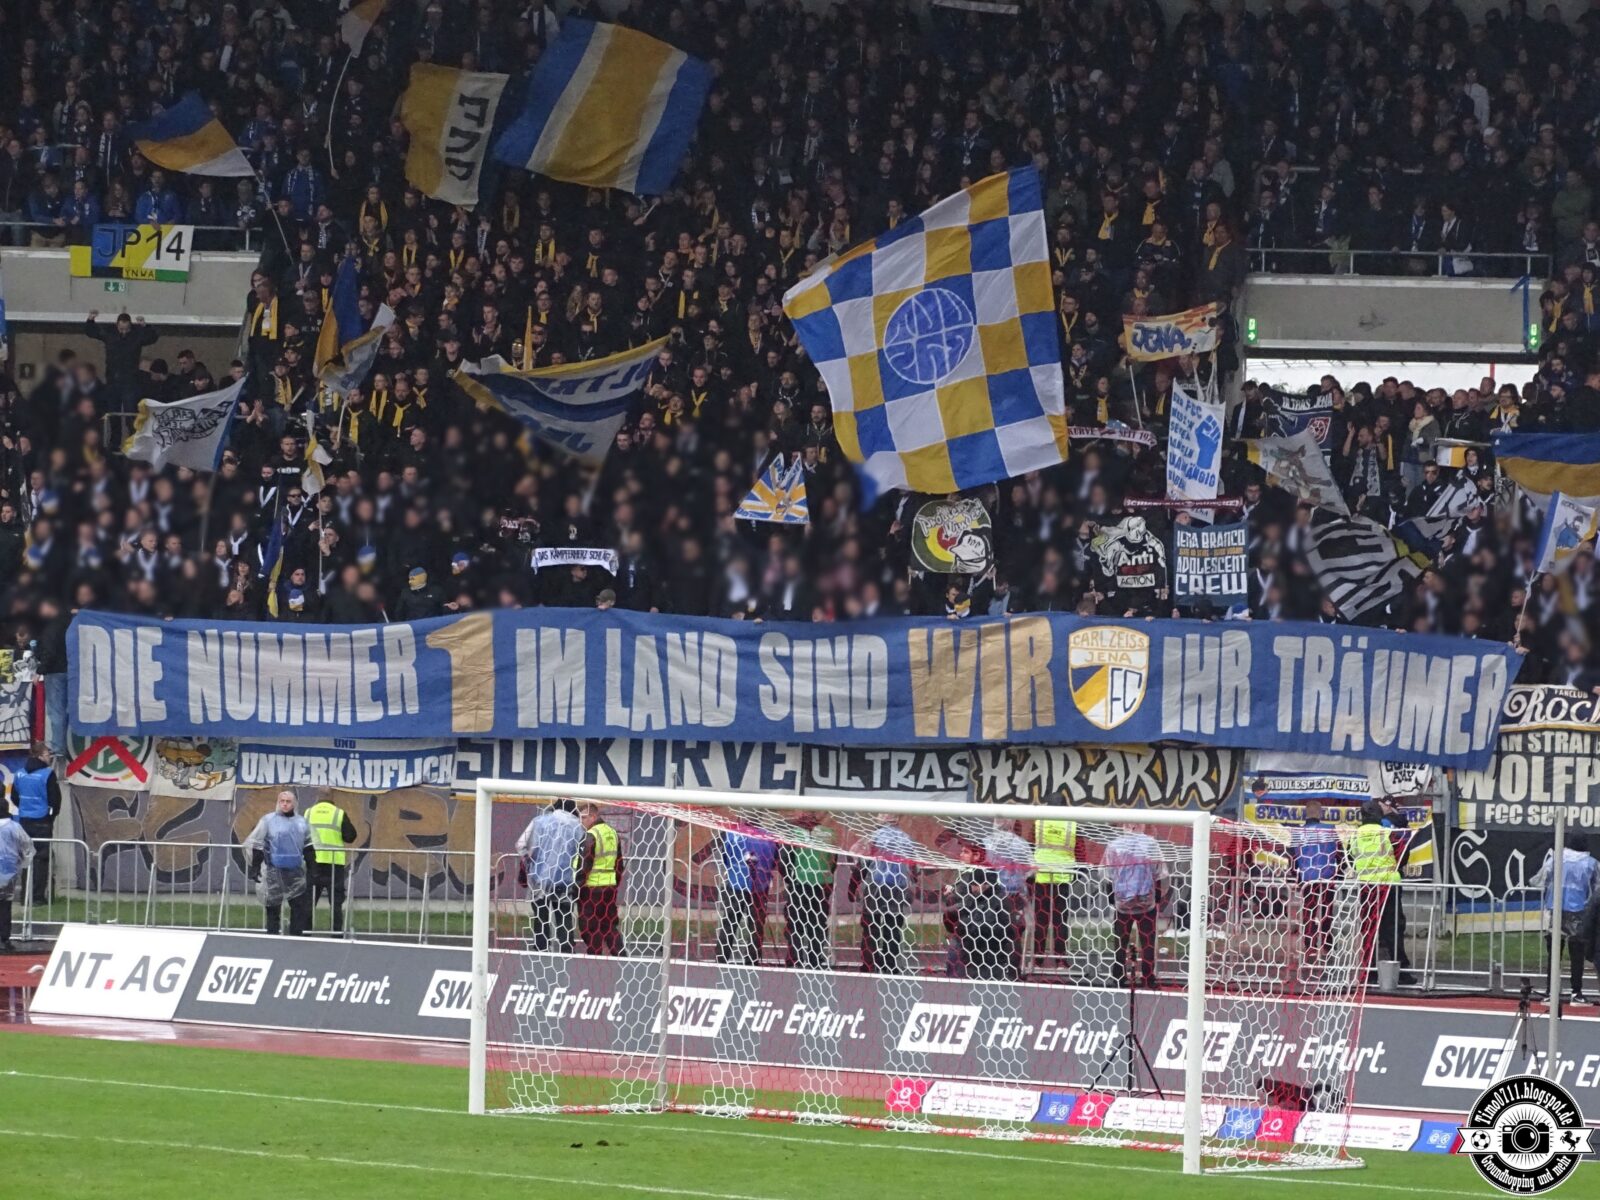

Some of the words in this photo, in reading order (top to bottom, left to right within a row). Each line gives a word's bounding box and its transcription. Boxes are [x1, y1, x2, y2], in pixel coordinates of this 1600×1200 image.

[124, 269, 155, 278] YNWA
[1201, 529, 1246, 549] BRANCO
[1118, 548, 1153, 567] Anti
[1176, 555, 1247, 575] ADOLESCENT
[1121, 575, 1154, 586] ACTION
[1175, 573, 1248, 596] CREW
[1084, 652, 1132, 664] JENA
[78, 624, 167, 727] DIE
[187, 623, 419, 726] NUMMER
[425, 611, 495, 733] 1
[515, 627, 586, 728] IM
[605, 627, 738, 732] LAND
[759, 631, 888, 733] SIND
[908, 616, 1056, 740] WIR
[1162, 630, 1251, 735] IHR
[1273, 635, 1508, 755] TRÄUMER
[1110, 667, 1142, 724] FC
[334, 739, 356, 749] UND
[241, 753, 454, 788] UNVERKÄUFLICH
[811, 750, 969, 790] ULTRAS
[975, 749, 1233, 801] HARAKIRI
[1267, 780, 1335, 791] ADOLESCENT
[1337, 781, 1370, 793] CREW
[1256, 805, 1341, 822] SAALLD
[1485, 803, 1523, 825] FCC
[208, 964, 262, 996] SWE
[273, 969, 319, 999] Für
[315, 971, 391, 1006] Erfurt.
[429, 979, 473, 1010] SW
[500, 984, 546, 1015] Für
[545, 986, 624, 1022] Erfurt.
[665, 993, 722, 1030] SWE
[737, 1000, 783, 1033] Für
[783, 1003, 866, 1040] Erfurt.
[910, 1011, 971, 1046] SWE
[986, 1016, 1033, 1050] Für
[1033, 1019, 1121, 1057] Erfurt.
[1247, 1033, 1297, 1068] Für
[1297, 1035, 1388, 1075] Erfurt.
[1435, 1045, 1498, 1080] SWE
